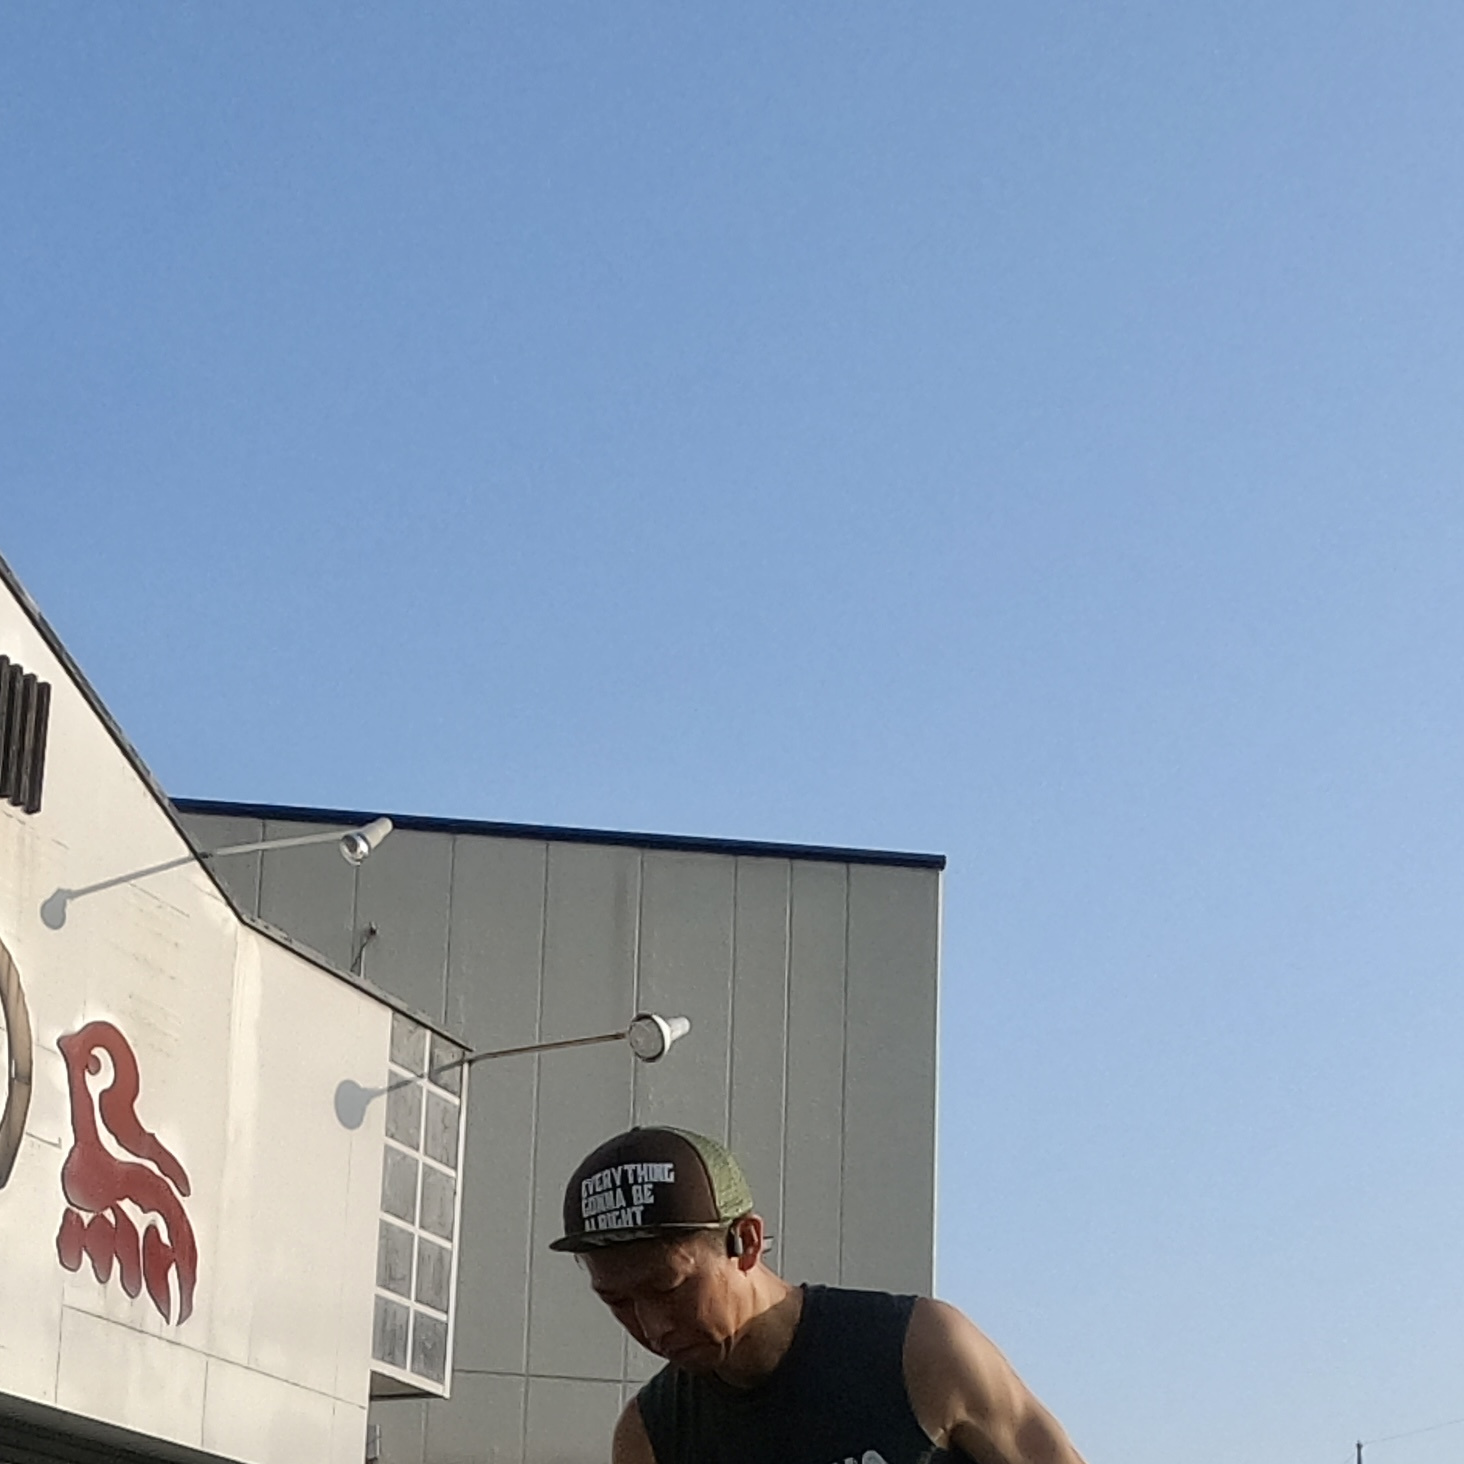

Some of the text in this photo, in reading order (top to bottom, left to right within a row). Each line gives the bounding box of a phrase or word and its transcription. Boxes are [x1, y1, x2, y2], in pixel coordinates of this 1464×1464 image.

[581, 1162, 676, 1198] EVERYTHING
[581, 1183, 655, 1218] GONNA BE
[584, 1205, 644, 1232] ALRIGHT
